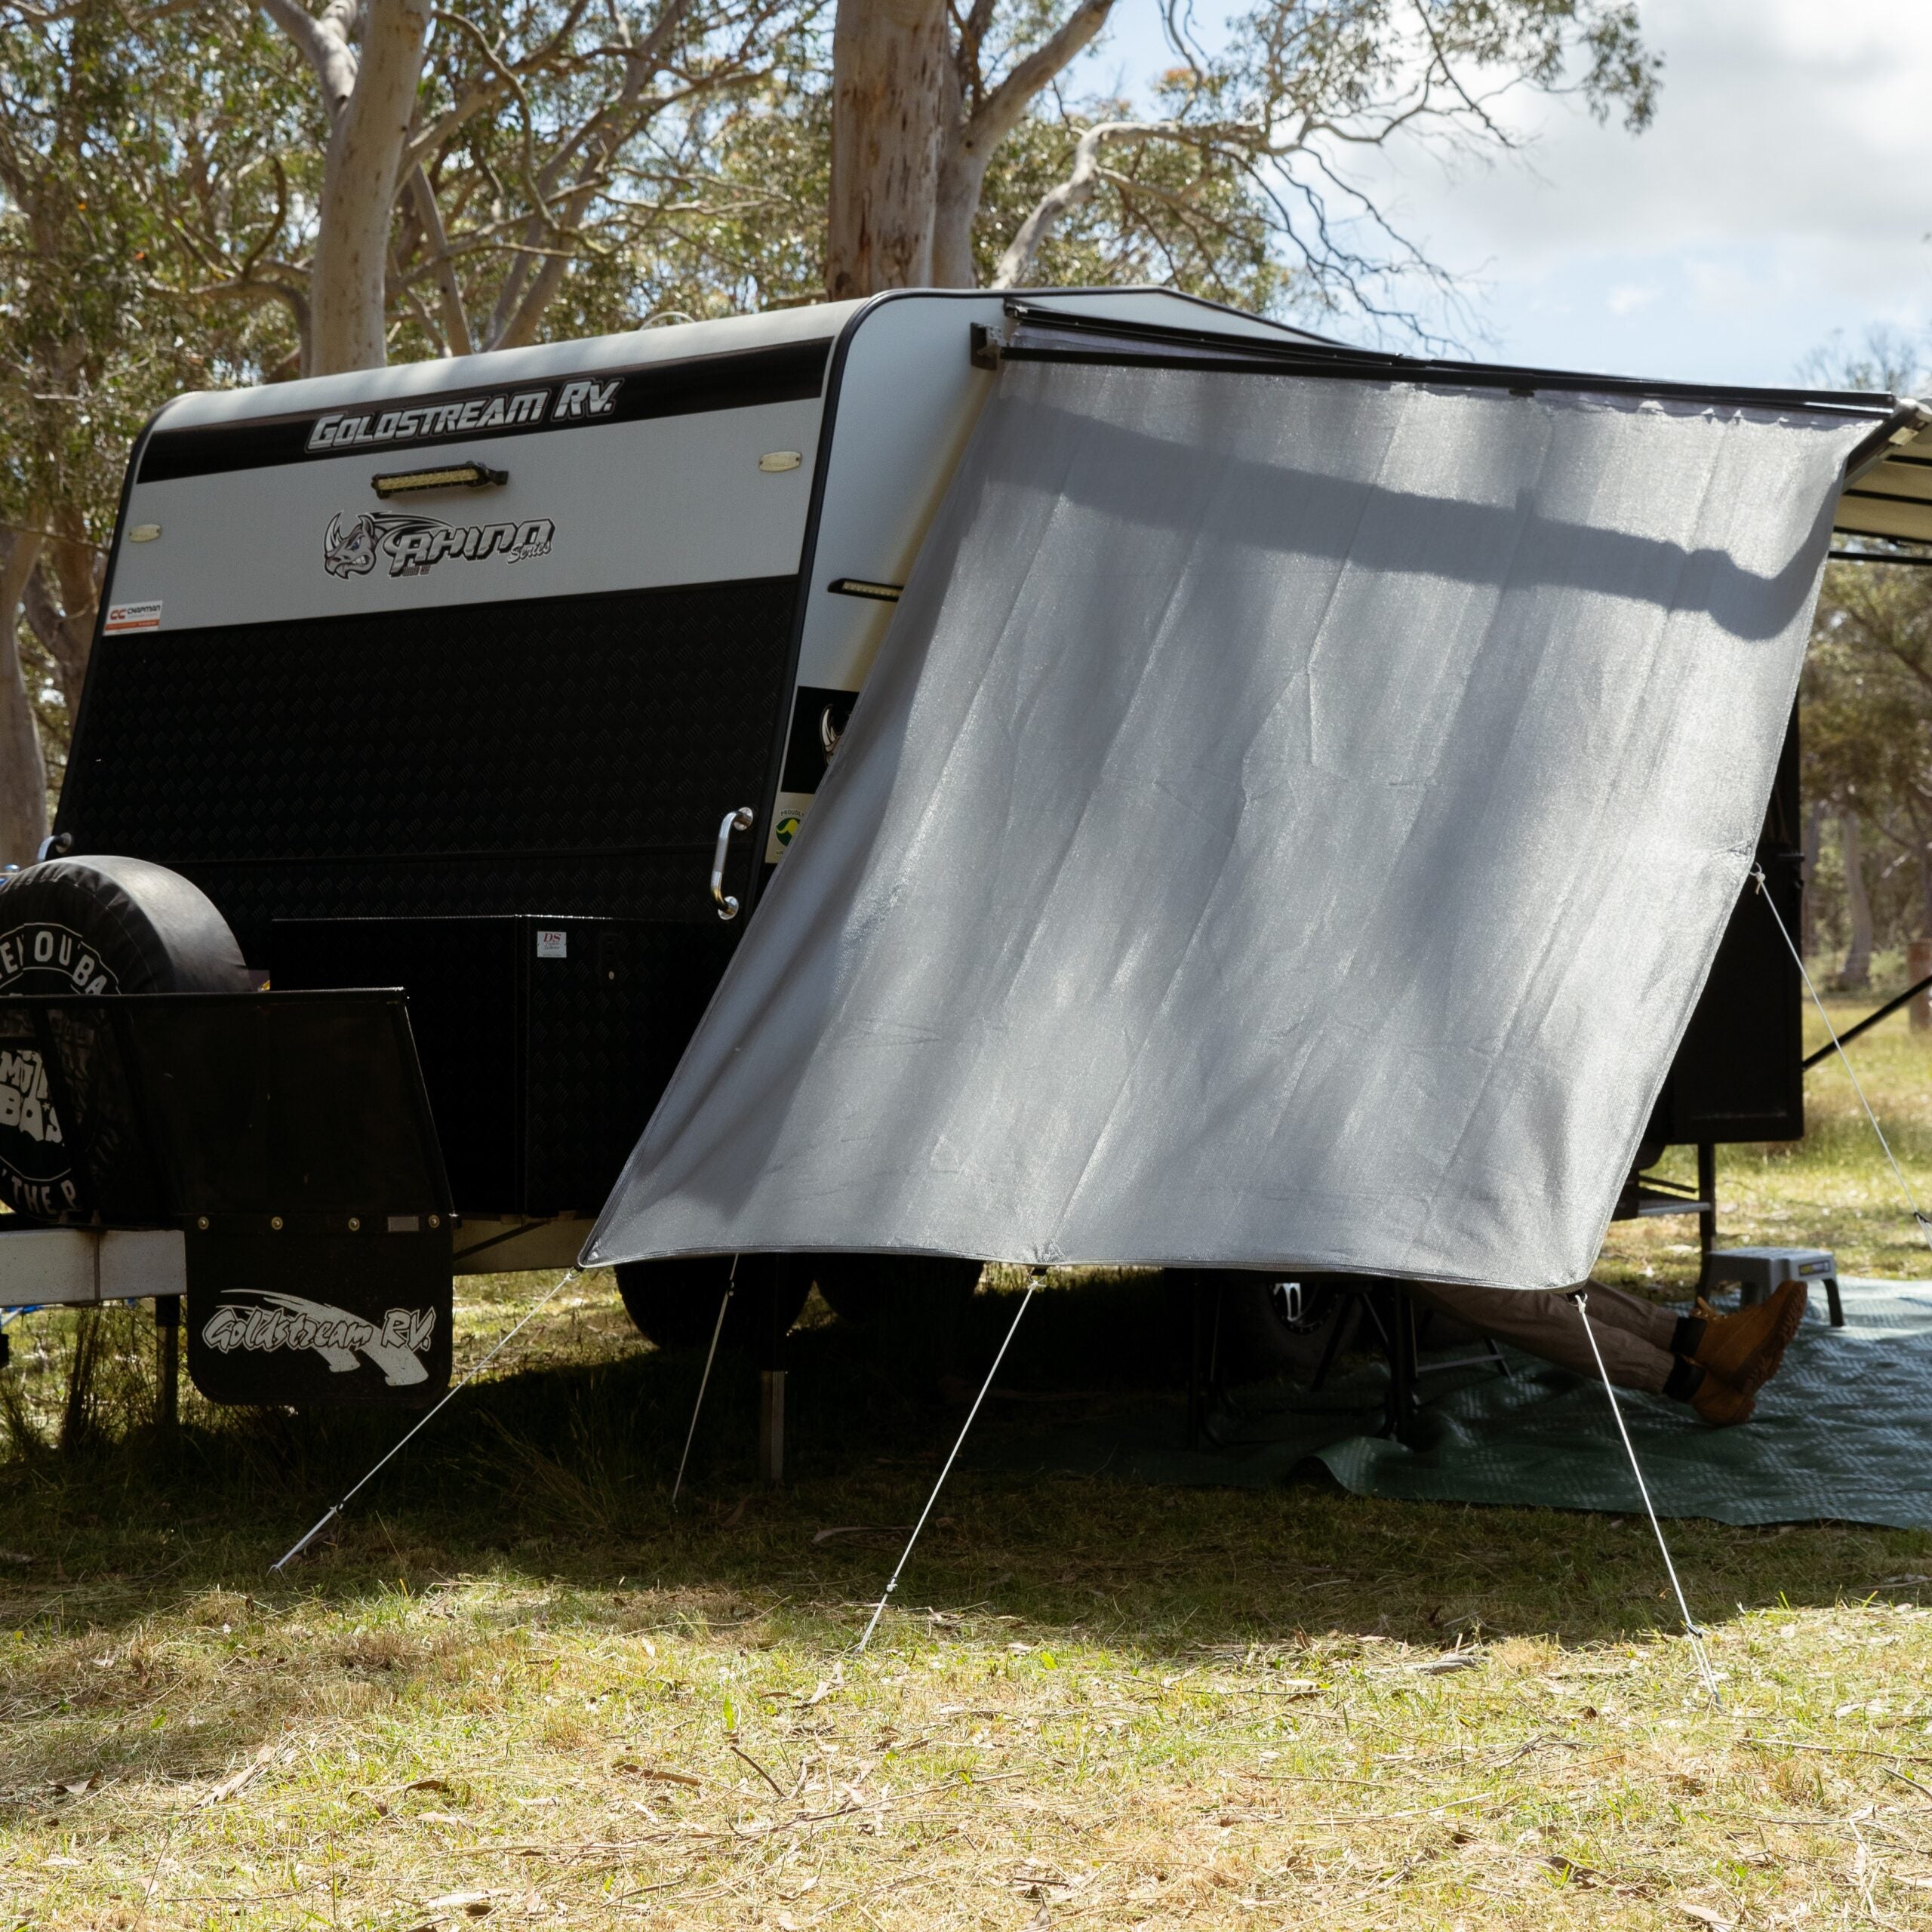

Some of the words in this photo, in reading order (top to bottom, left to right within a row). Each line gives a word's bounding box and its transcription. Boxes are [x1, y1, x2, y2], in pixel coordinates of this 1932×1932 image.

[307, 391, 549, 451] GOLDSTREAM
[383, 519, 555, 578] RHINO
[506, 542, 552, 565] Series
[543, 933, 561, 943] DS
[11, 1175, 58, 1215] THE
[202, 1306, 374, 1353] Goldstream
